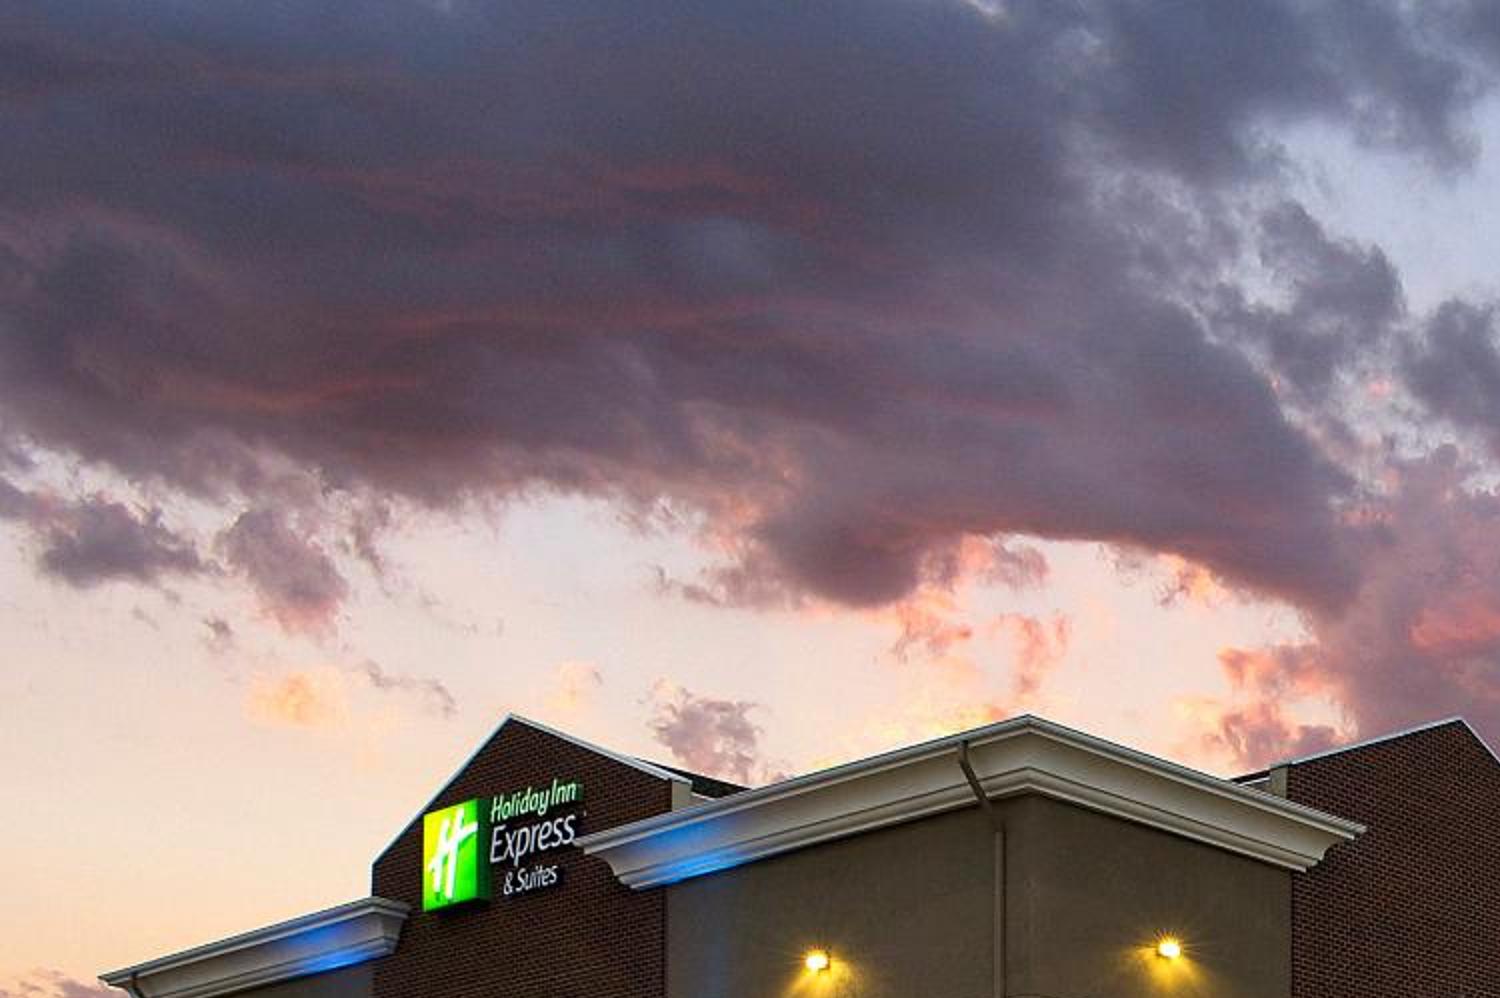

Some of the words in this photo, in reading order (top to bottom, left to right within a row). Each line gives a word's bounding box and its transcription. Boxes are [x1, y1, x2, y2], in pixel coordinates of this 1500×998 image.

[490, 786, 549, 823] Holiday
[550, 778, 577, 807] Inn
[489, 813, 577, 867] Express
[503, 871, 514, 895] &
[516, 864, 558, 892] Suites
